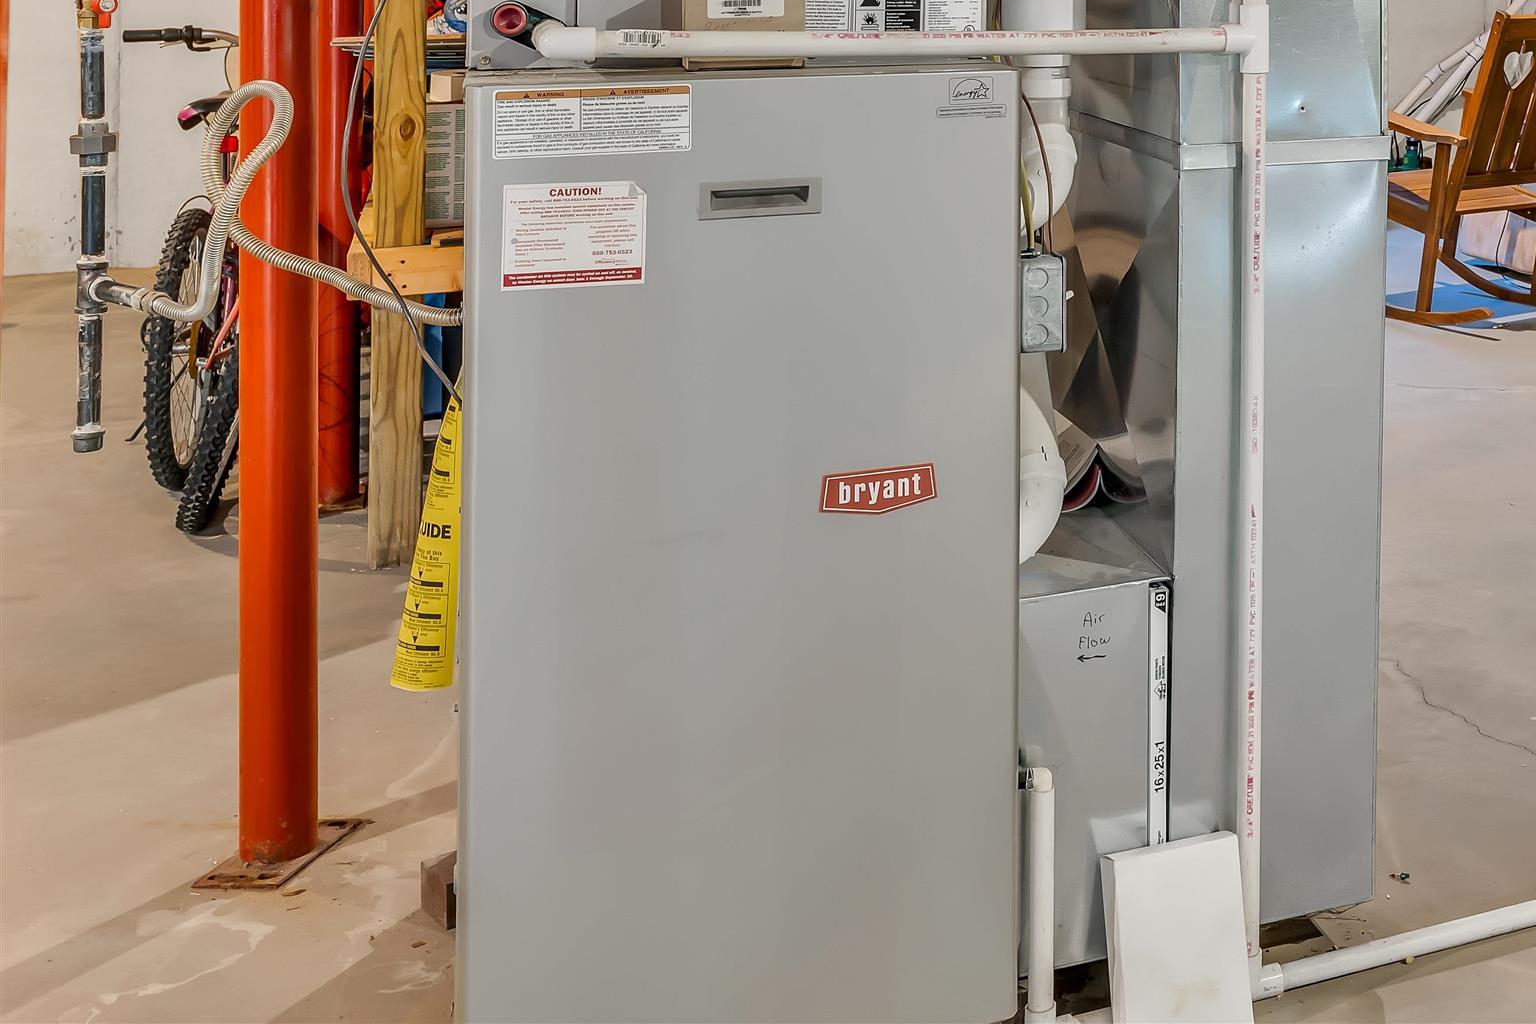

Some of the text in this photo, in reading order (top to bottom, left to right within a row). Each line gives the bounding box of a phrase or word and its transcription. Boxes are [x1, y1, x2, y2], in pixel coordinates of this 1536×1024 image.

[549, 188, 602, 196] CAUTION!
[838, 473, 921, 505] bryant
[420, 521, 451, 539] UIDE
[1155, 593, 1166, 602] 9
[1083, 612, 1106, 627] Air
[1078, 636, 1112, 650] Flow
[1154, 740, 1165, 794] 16x25x1
